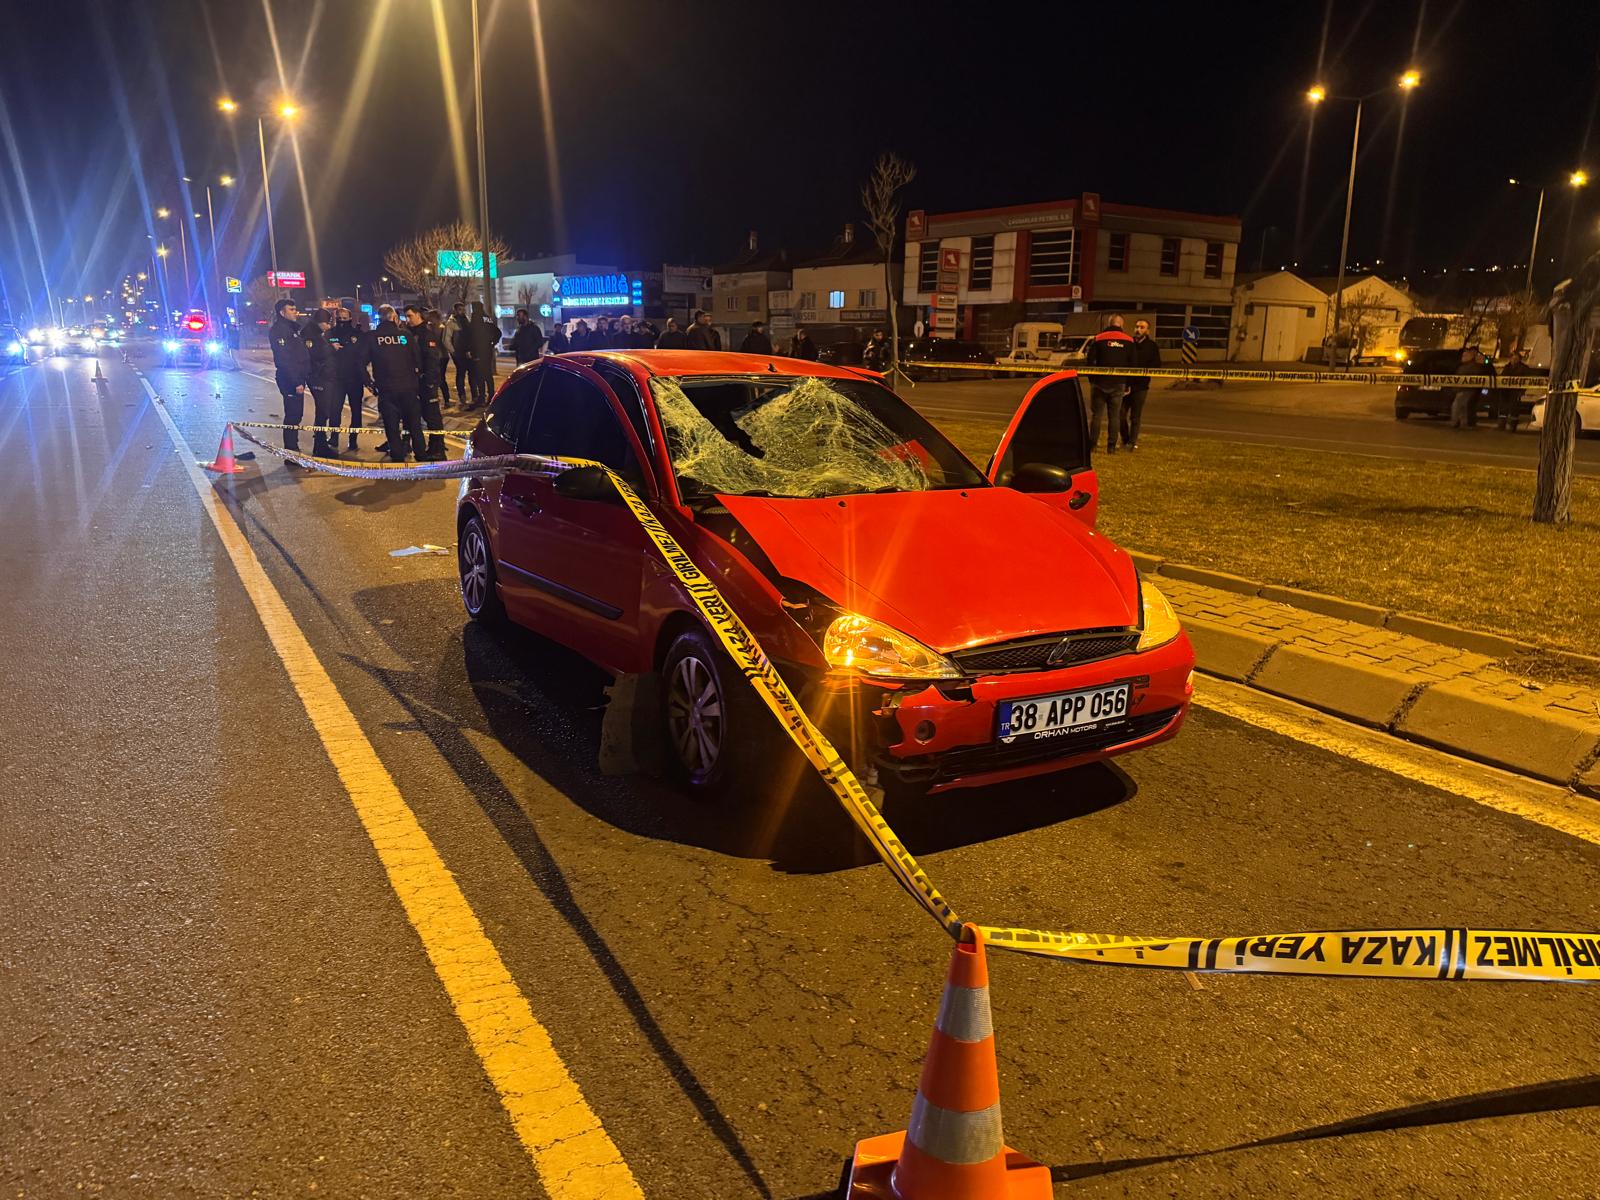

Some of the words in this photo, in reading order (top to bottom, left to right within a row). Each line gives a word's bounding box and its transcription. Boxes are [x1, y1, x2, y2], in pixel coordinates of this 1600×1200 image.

[570, 275, 617, 294] YAMANLAR
[656, 534, 701, 580] GİRİLMEZ
[698, 594, 733, 625] YERİ
[1010, 703, 1038, 732] 38
[1045, 695, 1085, 727] APP
[1090, 688, 1126, 718] 056
[1001, 722, 1010, 730] TR
[1034, 727, 1070, 740] ORHAN
[1070, 723, 1097, 733] MOTORS
[1234, 935, 1326, 966] YERİ
[1342, 935, 1435, 966] KAZA
[1474, 935, 1600, 975] İRİLMEZ
